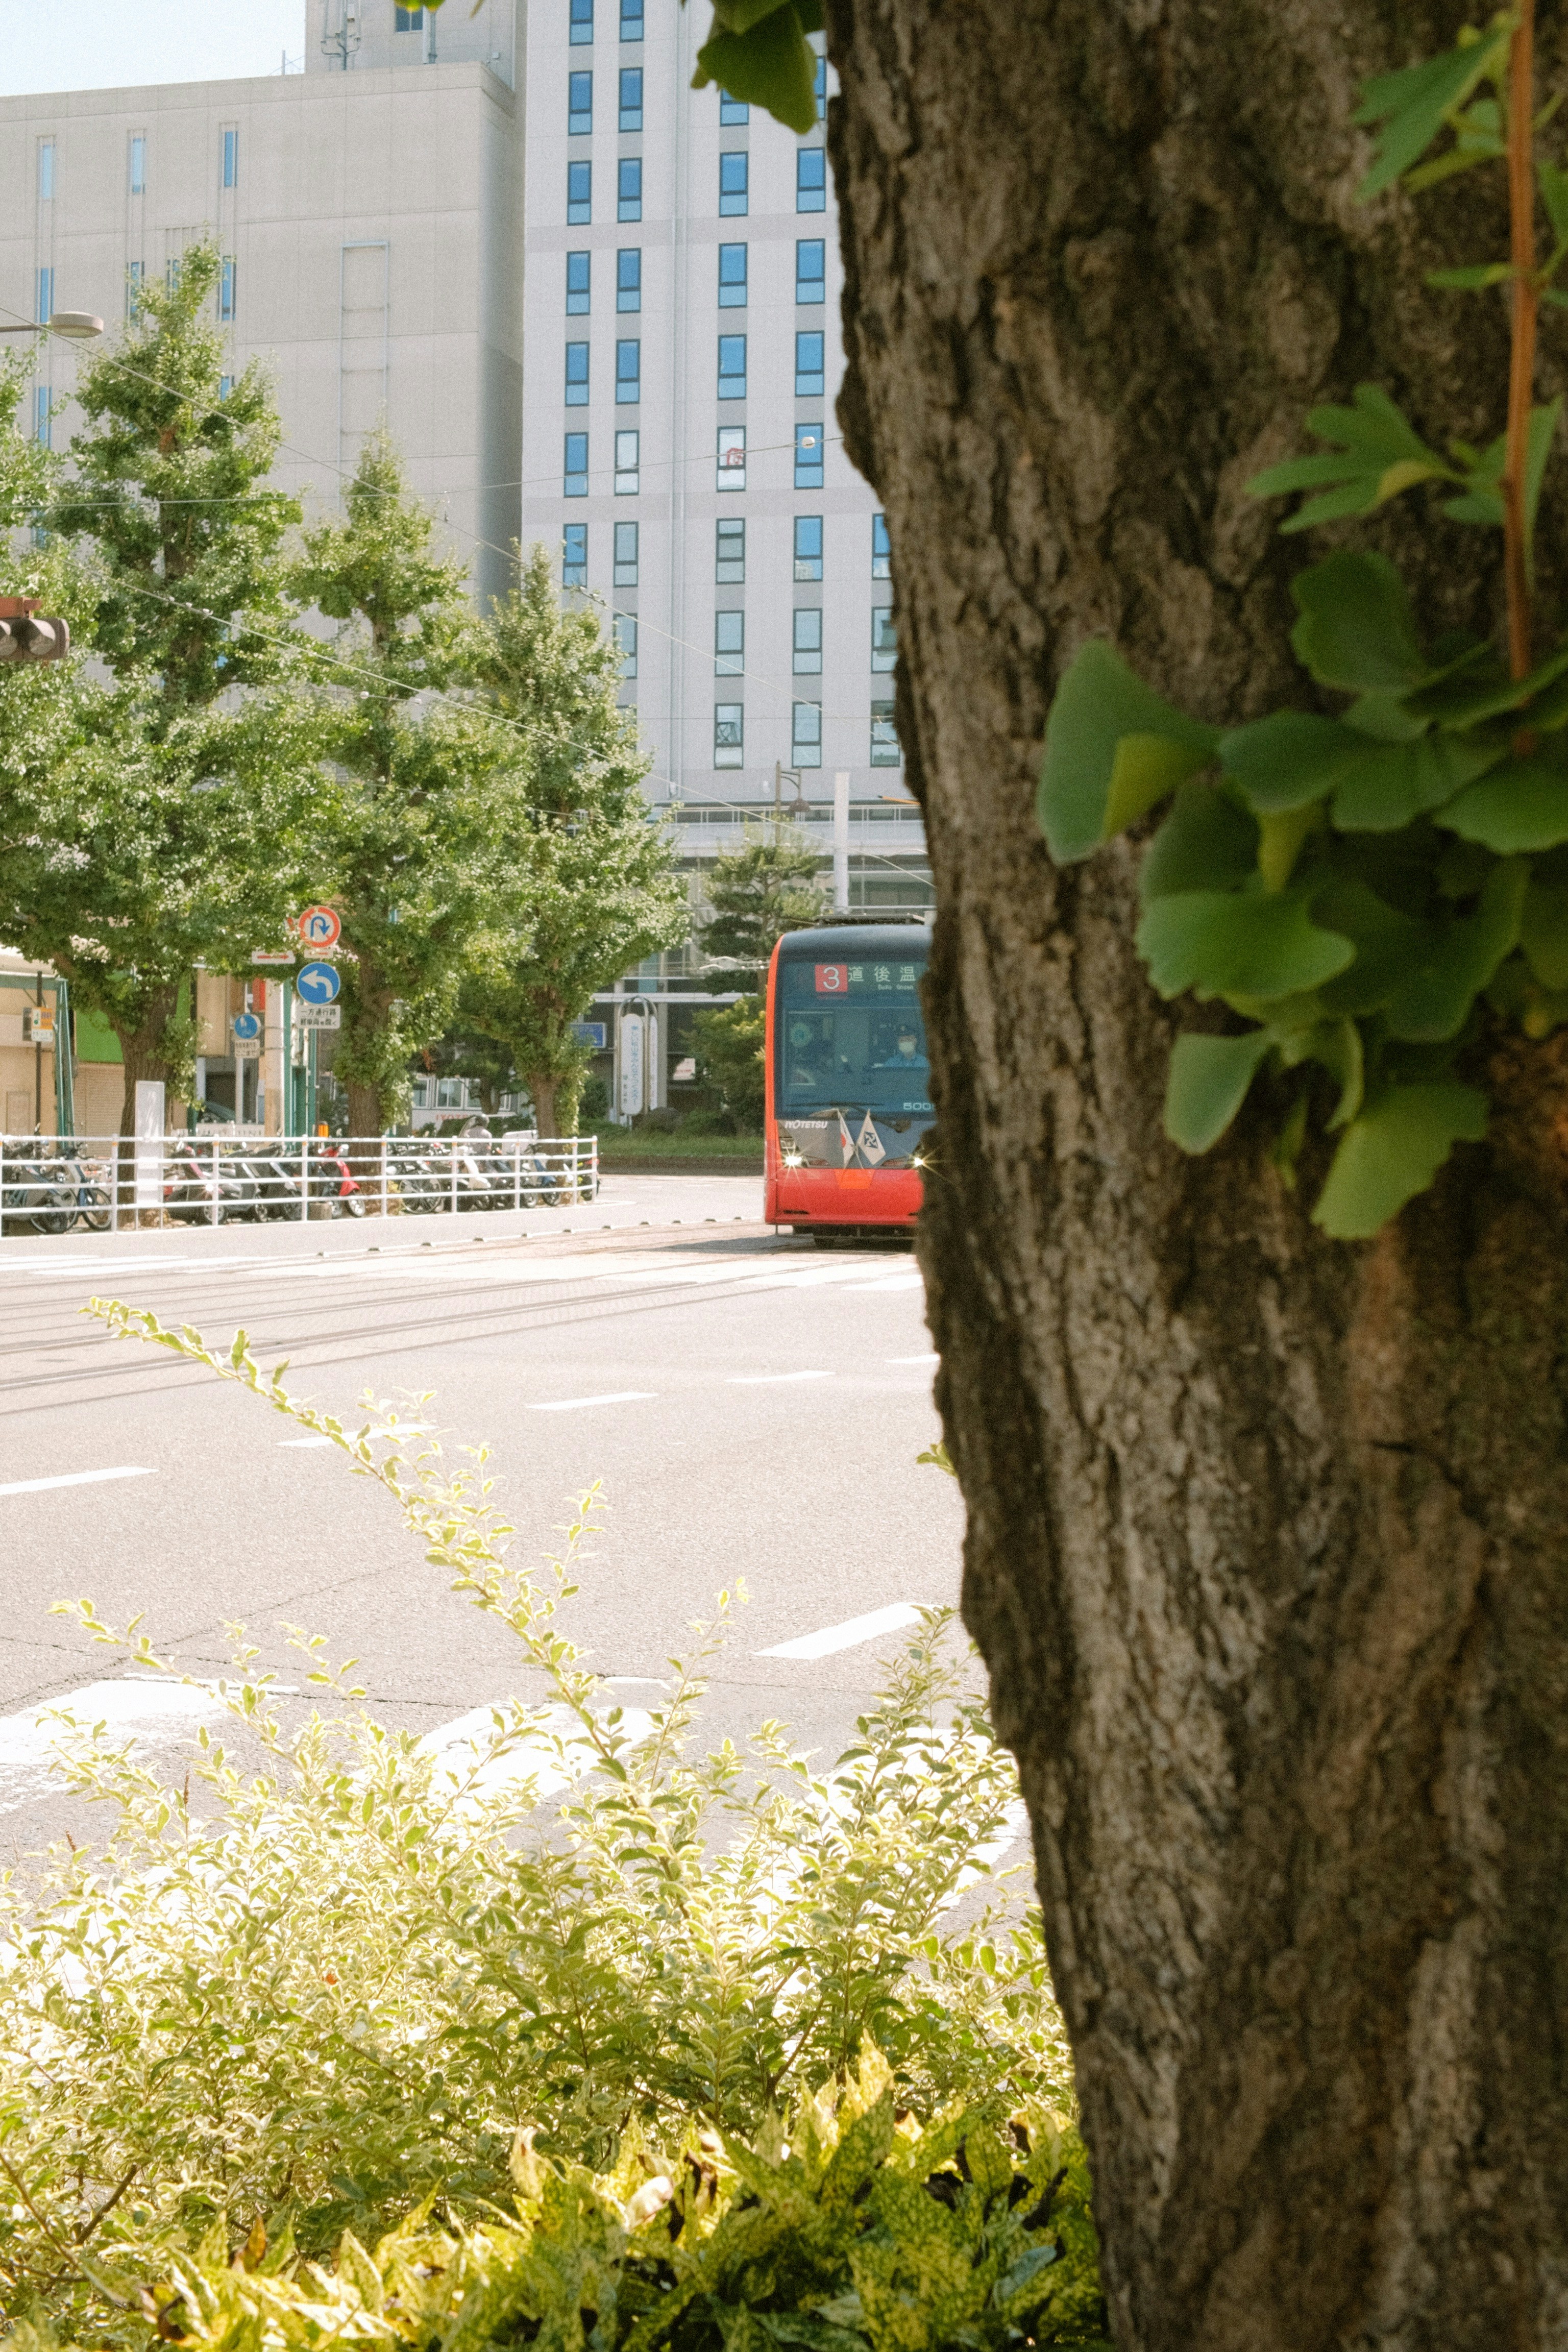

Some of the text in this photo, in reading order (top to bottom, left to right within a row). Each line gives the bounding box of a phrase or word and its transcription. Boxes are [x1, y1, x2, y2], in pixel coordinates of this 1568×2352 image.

[823, 967, 840, 989] 3
[848, 966, 929, 982] 道後温
[784, 1119, 828, 1129] IYOTETSU
